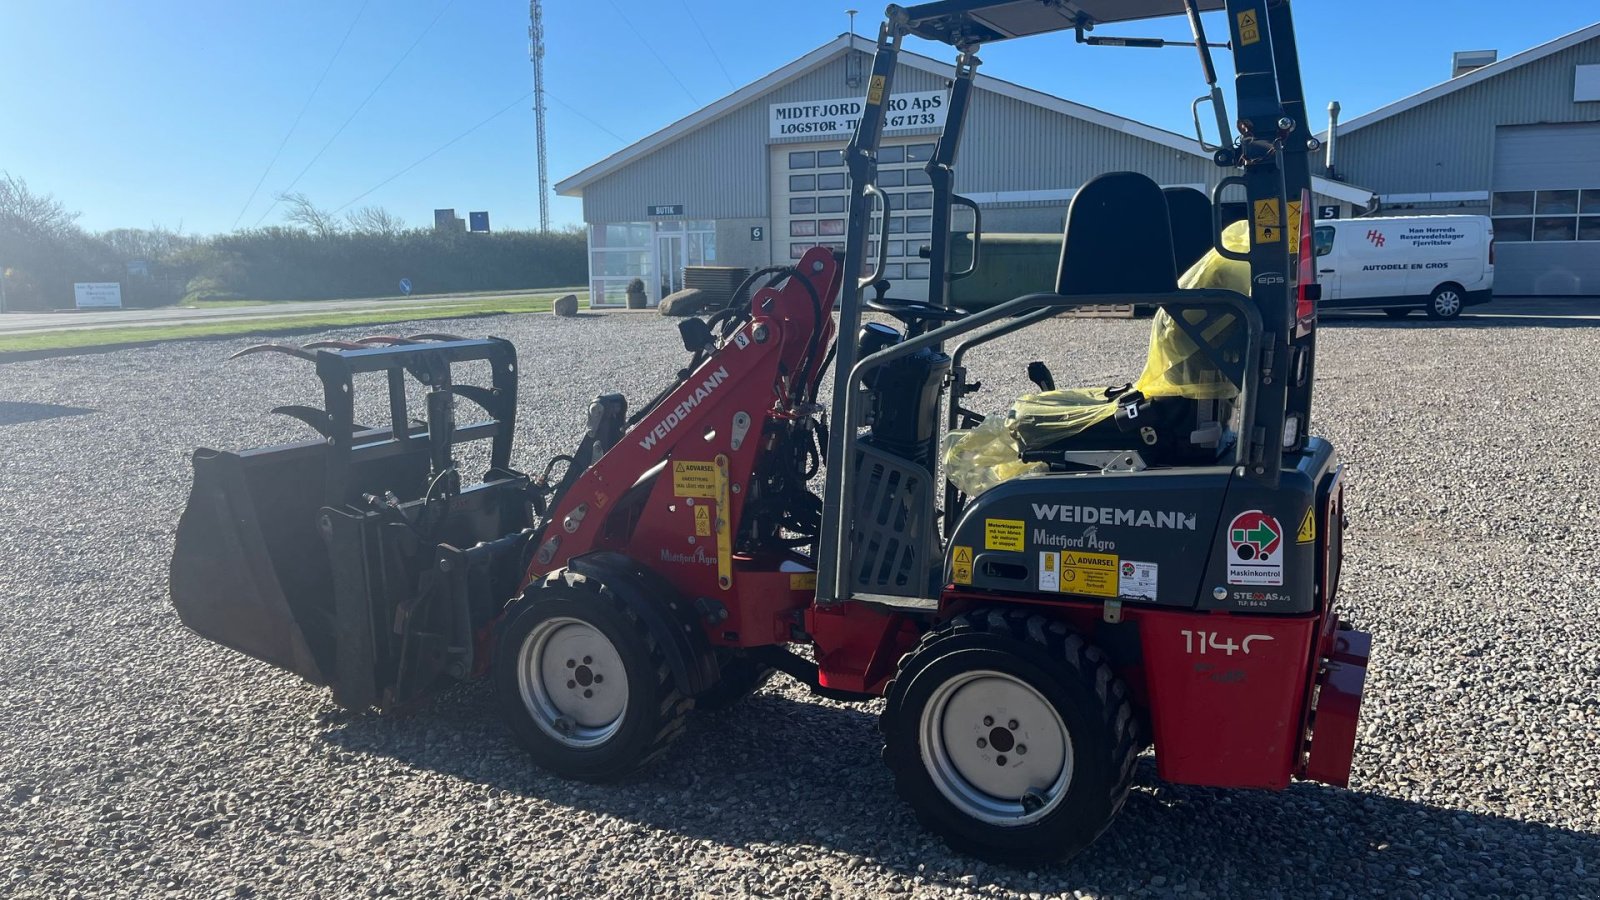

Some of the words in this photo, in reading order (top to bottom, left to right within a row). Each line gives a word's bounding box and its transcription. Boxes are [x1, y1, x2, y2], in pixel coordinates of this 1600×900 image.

[776, 103, 860, 120] MIDTFJORD
[887, 99, 907, 111] RO
[911, 95, 942, 112] ApS
[781, 121, 836, 134] LØGSTØR
[891, 116, 904, 127] 67
[656, 206, 674, 215] BUTIK
[1324, 206, 1335, 218] 5
[753, 228, 760, 237] 6
[1362, 263, 1409, 271] AUTODELE
[639, 365, 729, 451] WEIDEMANN
[1031, 503, 1197, 531] WEIDEMANN
[1033, 528, 1084, 549] Midtfjord
[1087, 532, 1115, 552] Agro
[1078, 557, 1114, 566] ADVARSEL
